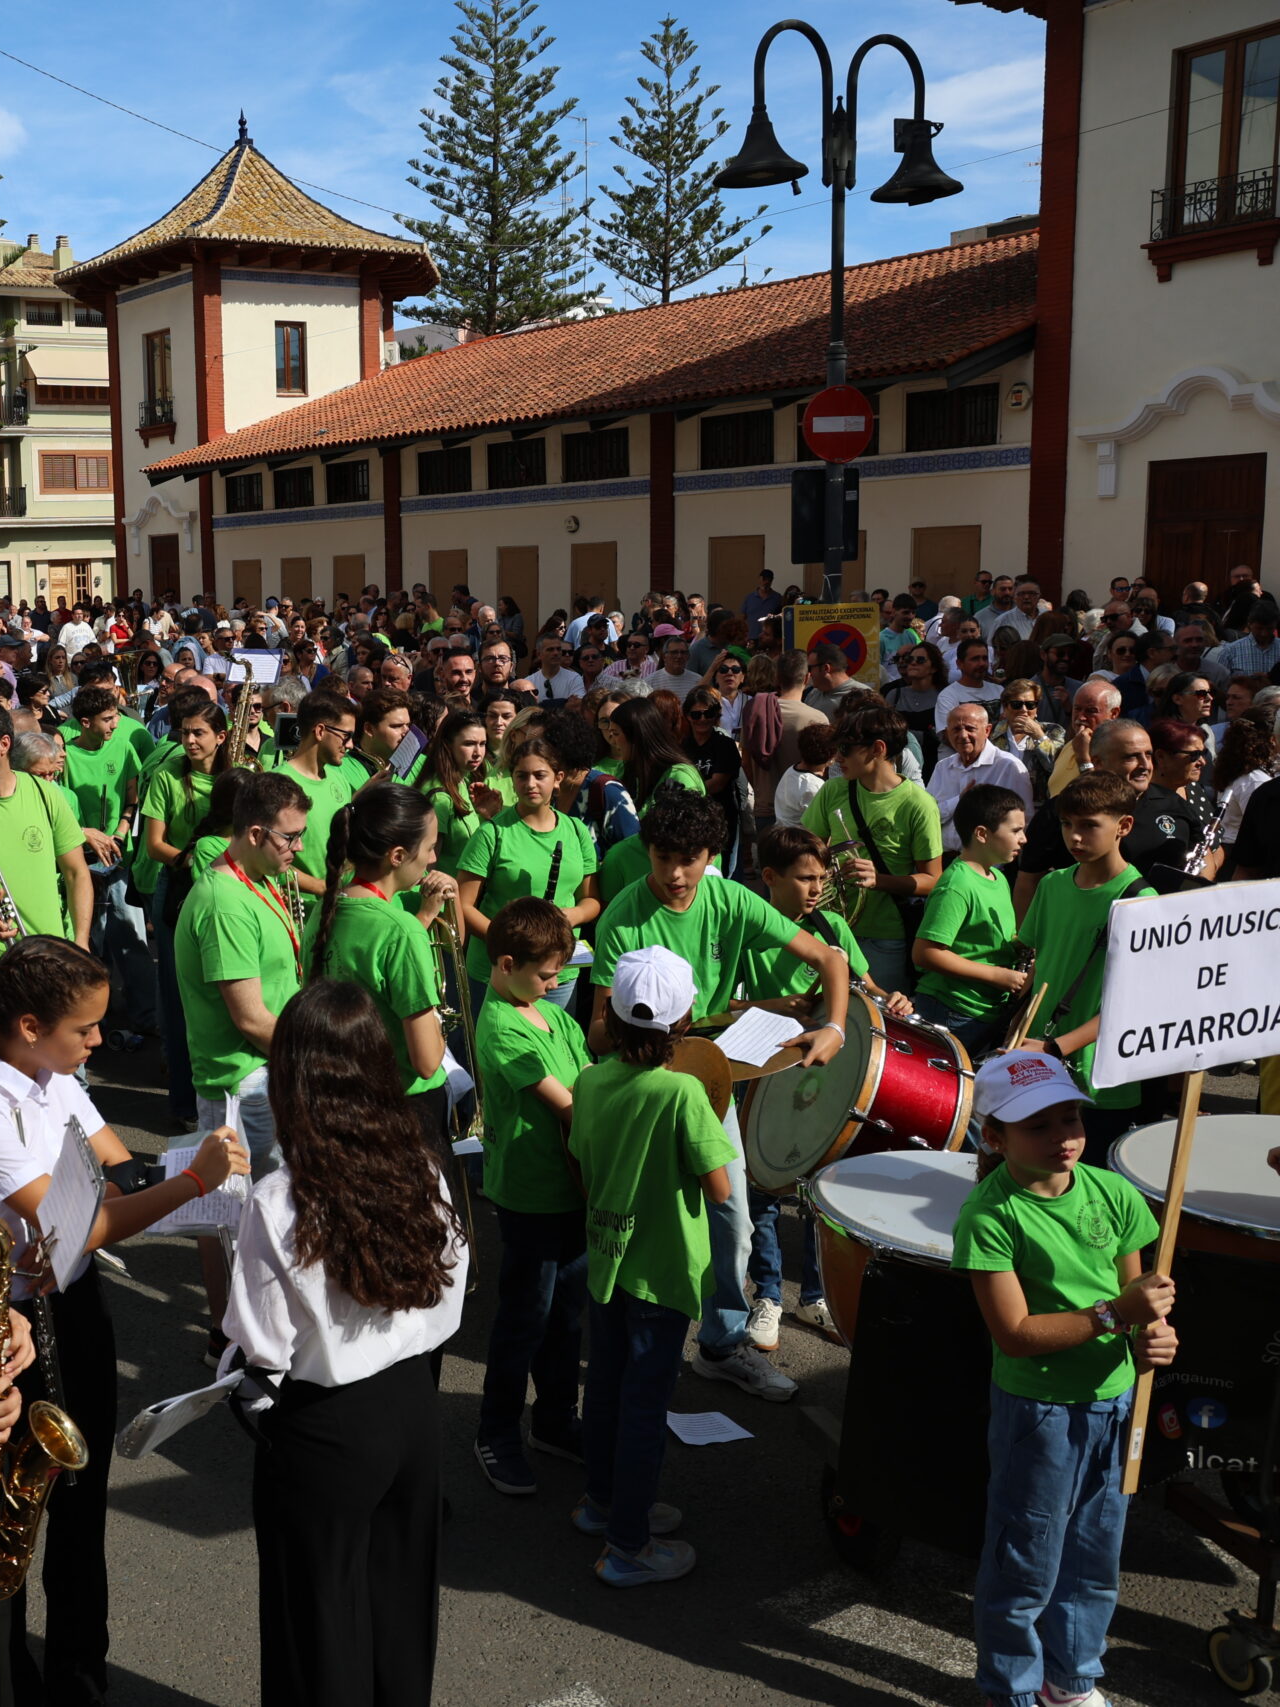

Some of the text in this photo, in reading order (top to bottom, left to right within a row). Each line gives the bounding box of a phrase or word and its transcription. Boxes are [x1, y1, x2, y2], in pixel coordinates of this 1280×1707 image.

[840, 606, 874, 614] EXCEPCIONAL
[1130, 908, 1280, 953] UNIÓ MUSIC
[1197, 963, 1228, 989] DE
